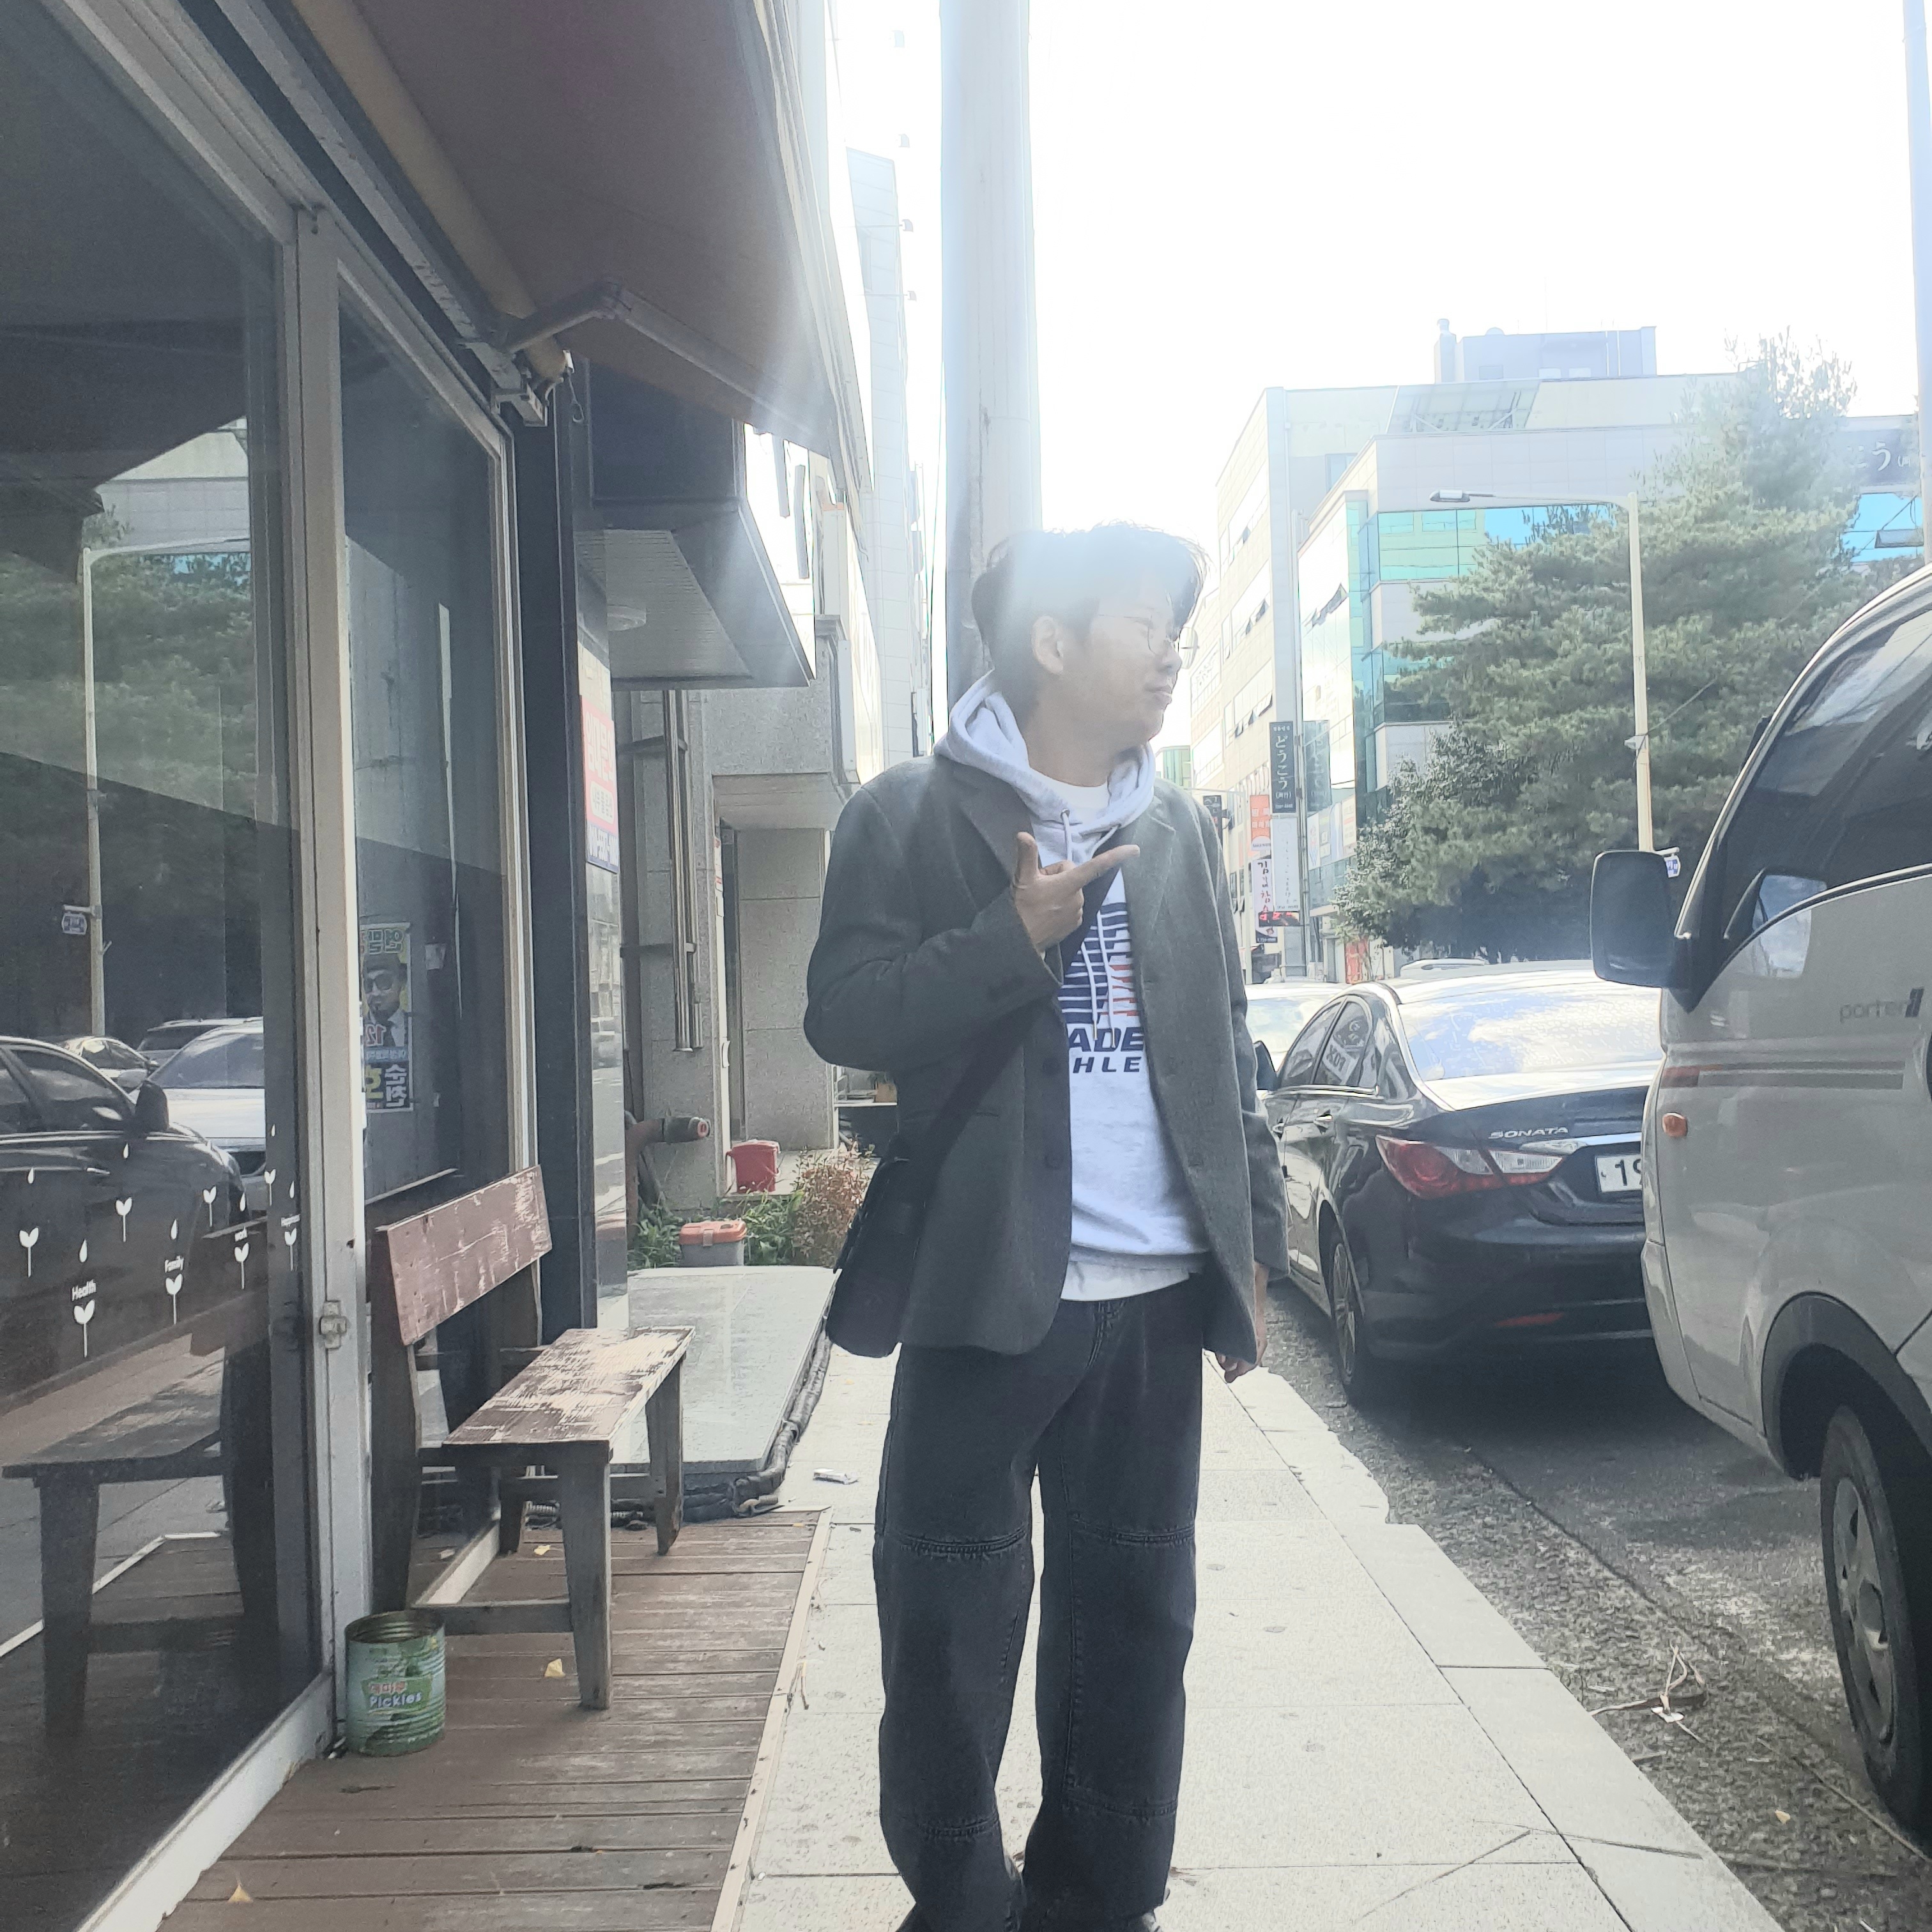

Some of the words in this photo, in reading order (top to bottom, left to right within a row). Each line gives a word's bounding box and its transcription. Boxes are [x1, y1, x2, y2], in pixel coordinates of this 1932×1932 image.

[1275, 735, 1289, 790] どうこう
[1488, 1126, 1569, 1140] SONATA
